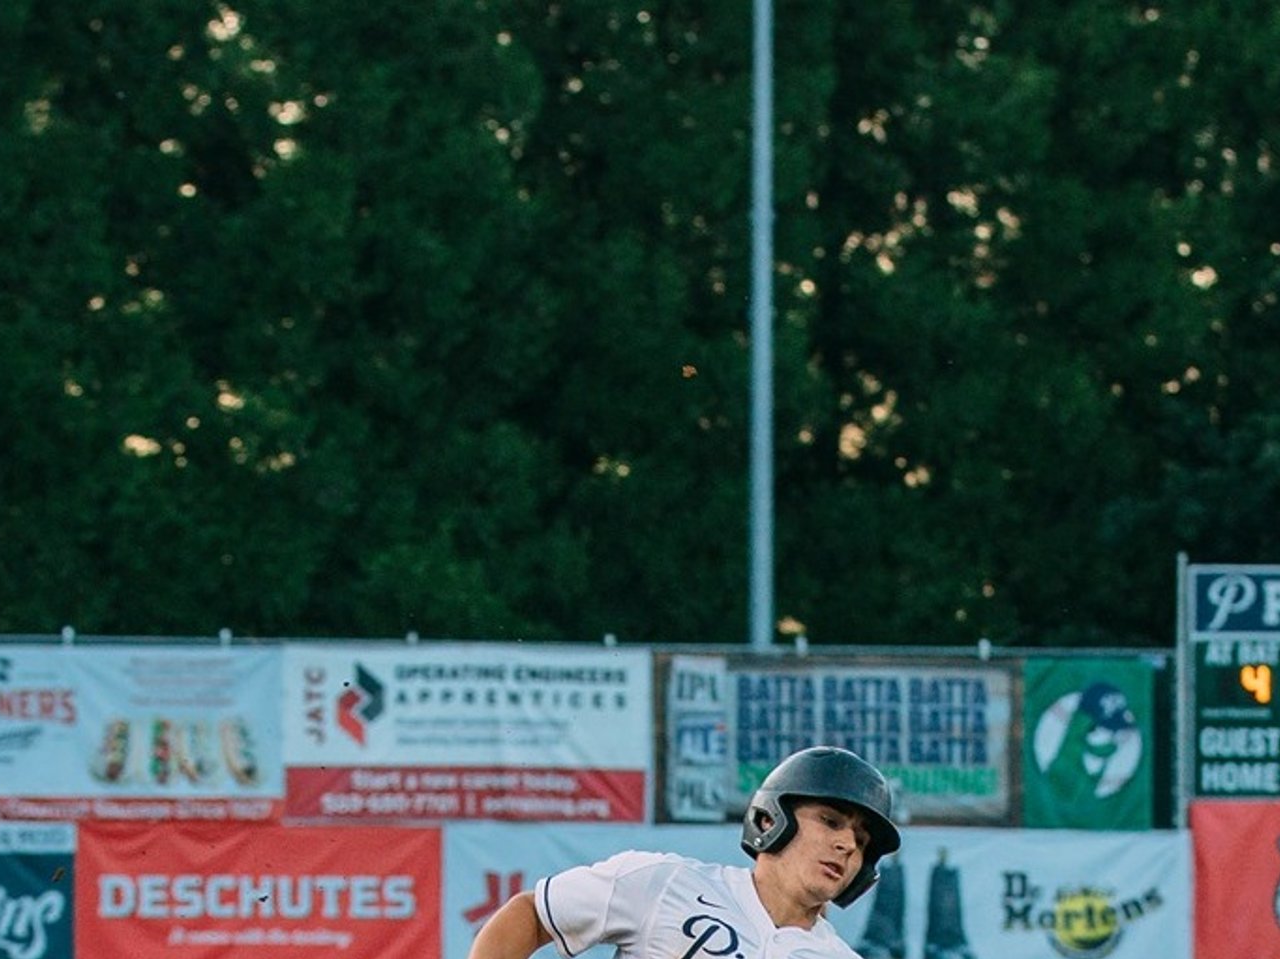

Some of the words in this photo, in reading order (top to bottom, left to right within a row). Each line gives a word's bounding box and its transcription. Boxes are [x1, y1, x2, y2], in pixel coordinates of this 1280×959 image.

[1204, 642, 1234, 665] AT
[1238, 642, 1280, 666] BAT
[394, 664, 505, 682] OPERATING
[513, 666, 627, 685] ENGINEERS
[737, 676, 816, 702] BATTA
[823, 677, 901, 702] BATTA
[909, 678, 987, 703] BATTA
[1239, 664, 1271, 704] 4
[304, 667, 326, 744] JATC
[394, 690, 627, 709] APPRENTICES
[1201, 762, 1280, 792] HOME
[98, 874, 417, 919] DESCHUTES
[1004, 887, 1162, 931] Martens
